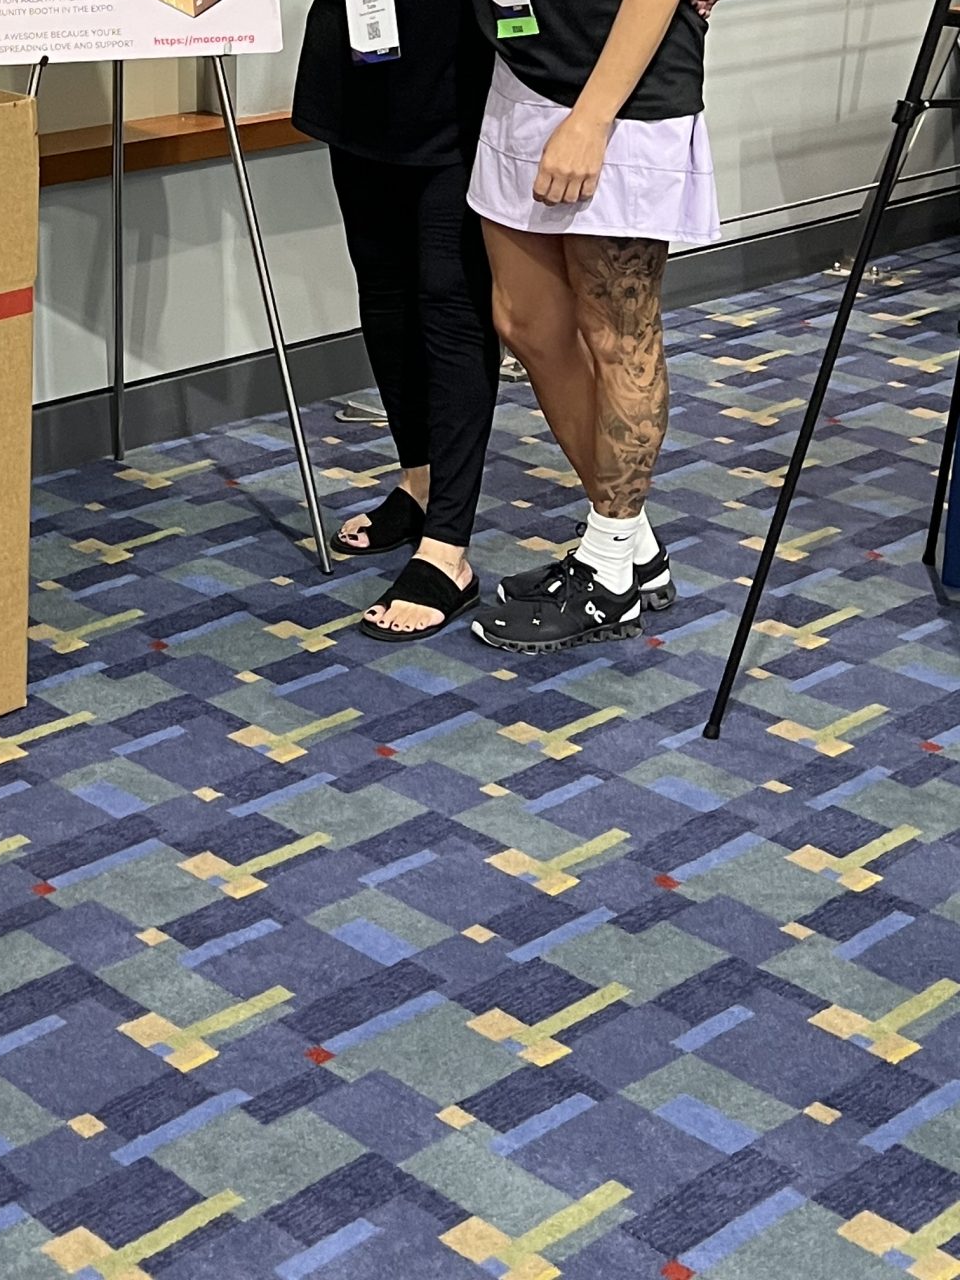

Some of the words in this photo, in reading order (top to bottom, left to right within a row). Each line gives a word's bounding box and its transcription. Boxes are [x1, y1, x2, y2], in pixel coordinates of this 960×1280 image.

[29, 7, 60, 15] BOOTH
[73, 5, 89, 13] THE
[4, 31, 49, 40] AWESOME
[50, 30, 88, 39] BECAUSE
[153, 34, 255, 47] https://macona.org
[0, 43, 48, 53] SPREADING
[50, 41, 71, 51] LOVE
[74, 41, 93, 50] AND
[95, 40, 134, 49] SUPPORT
